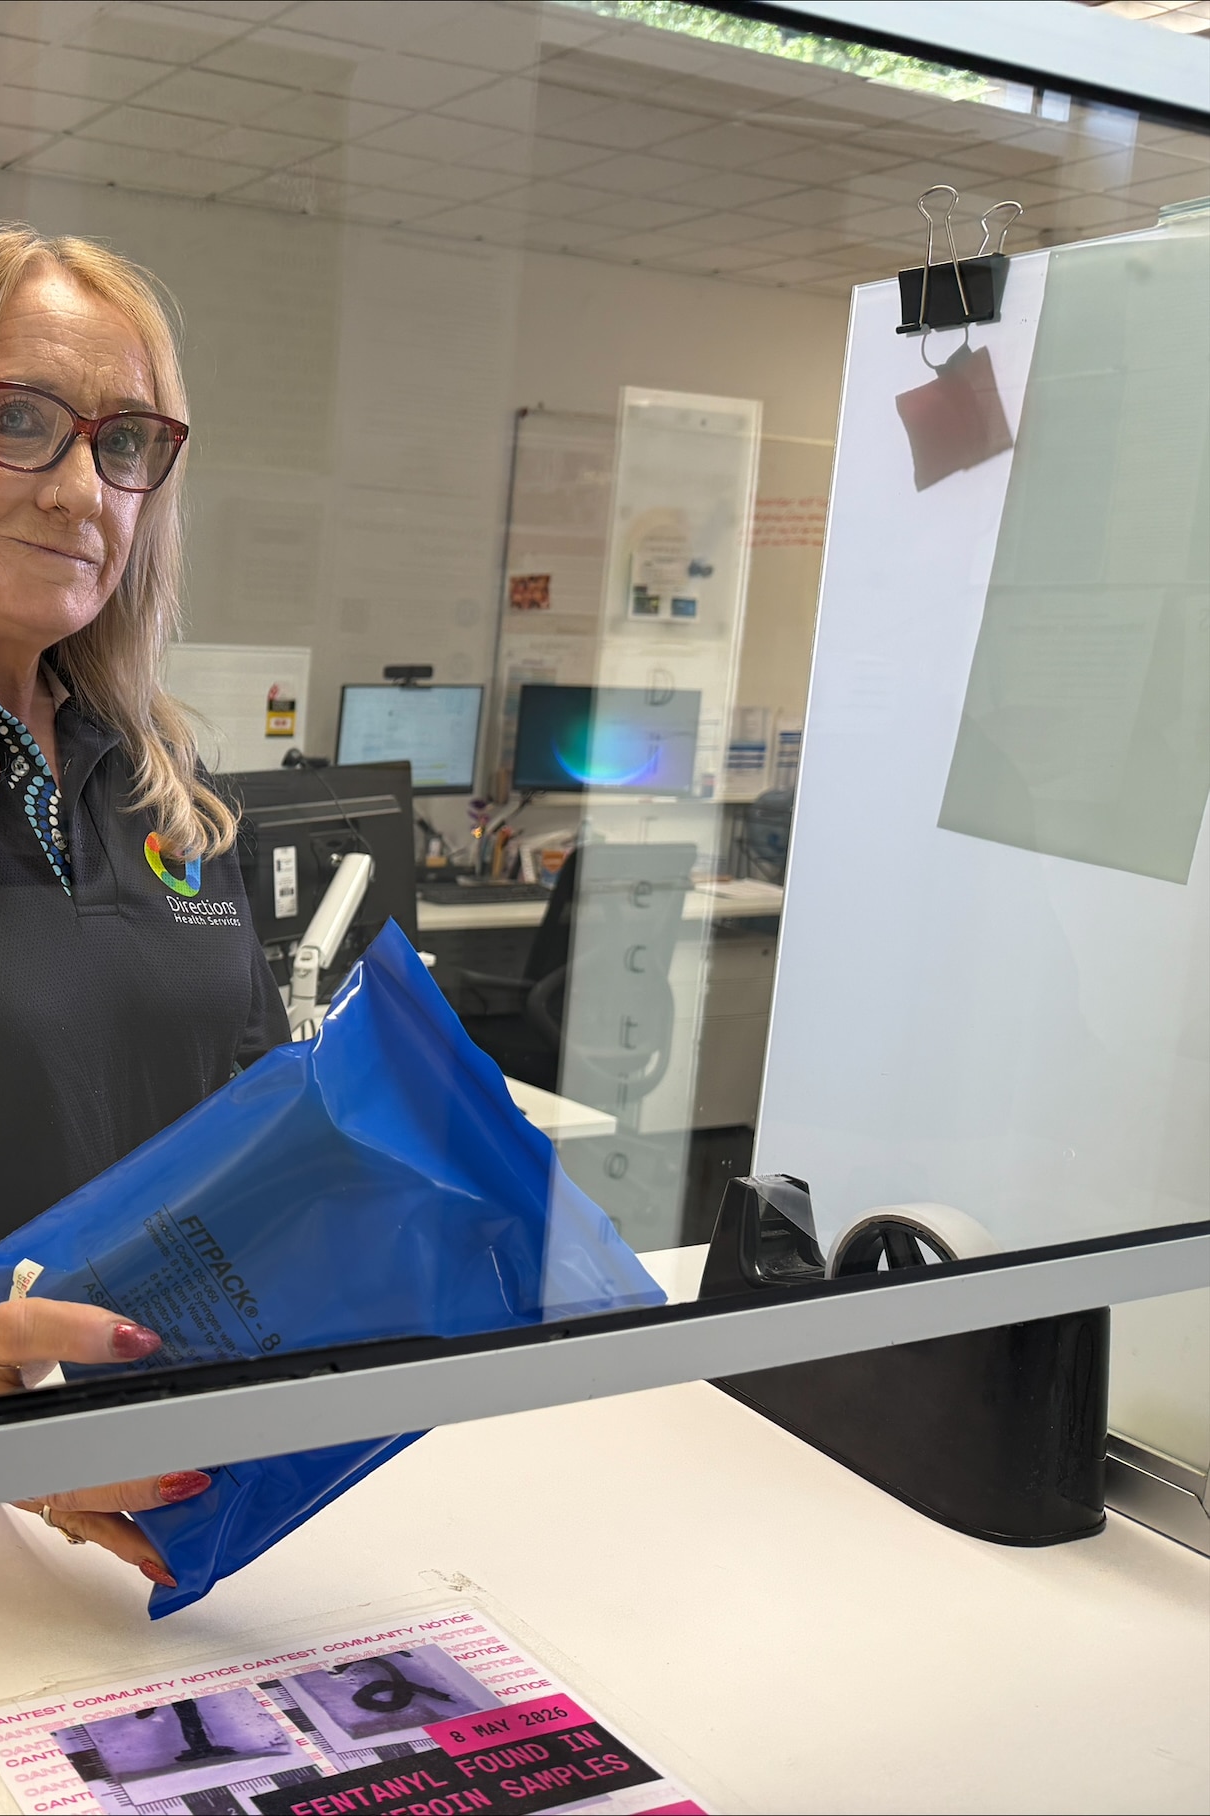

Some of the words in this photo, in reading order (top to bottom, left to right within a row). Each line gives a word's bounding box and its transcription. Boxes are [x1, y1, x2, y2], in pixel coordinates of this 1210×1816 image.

[165, 895, 237, 916] Directions
[173, 913, 207, 926] Health
[207, 916, 241, 927] Services
[153, 1210, 178, 1243] Product
[174, 1244, 195, 1269] Code
[149, 1293, 174, 1327] Cotton
[159, 1287, 184, 1320] Swabs
[186, 1304, 210, 1331] Water
[203, 1330, 218, 1346] for
[192, 1291, 222, 1332] Syringes
[219, 1331, 237, 1353] with
[261, 1333, 282, 1351] 8
[430, 1625, 488, 1642] NOTICE
[443, 1636, 501, 1654] NOTICE
[72, 1680, 175, 1709] COMMUNITY
[181, 1665, 244, 1686] NOTICE
[242, 1648, 318, 1671] CANTEST
[322, 1626, 415, 1653] COMMUNITY
[418, 1613, 474, 1631] NOTICE
[453, 1644, 510, 1662] NOTICE
[466, 1655, 525, 1674] NOTICE
[479, 1667, 539, 1686] NOTICE
[493, 1679, 553, 1698] NOTICE
[449, 1730, 467, 1743] 8
[472, 1718, 511, 1738] MAY
[518, 1706, 569, 1726] 2026
[290, 1769, 449, 1814] FENTANYL
[454, 1743, 550, 1779] FOUND
[558, 1729, 603, 1753] IN
[499, 1753, 631, 1799] SAMPLES
